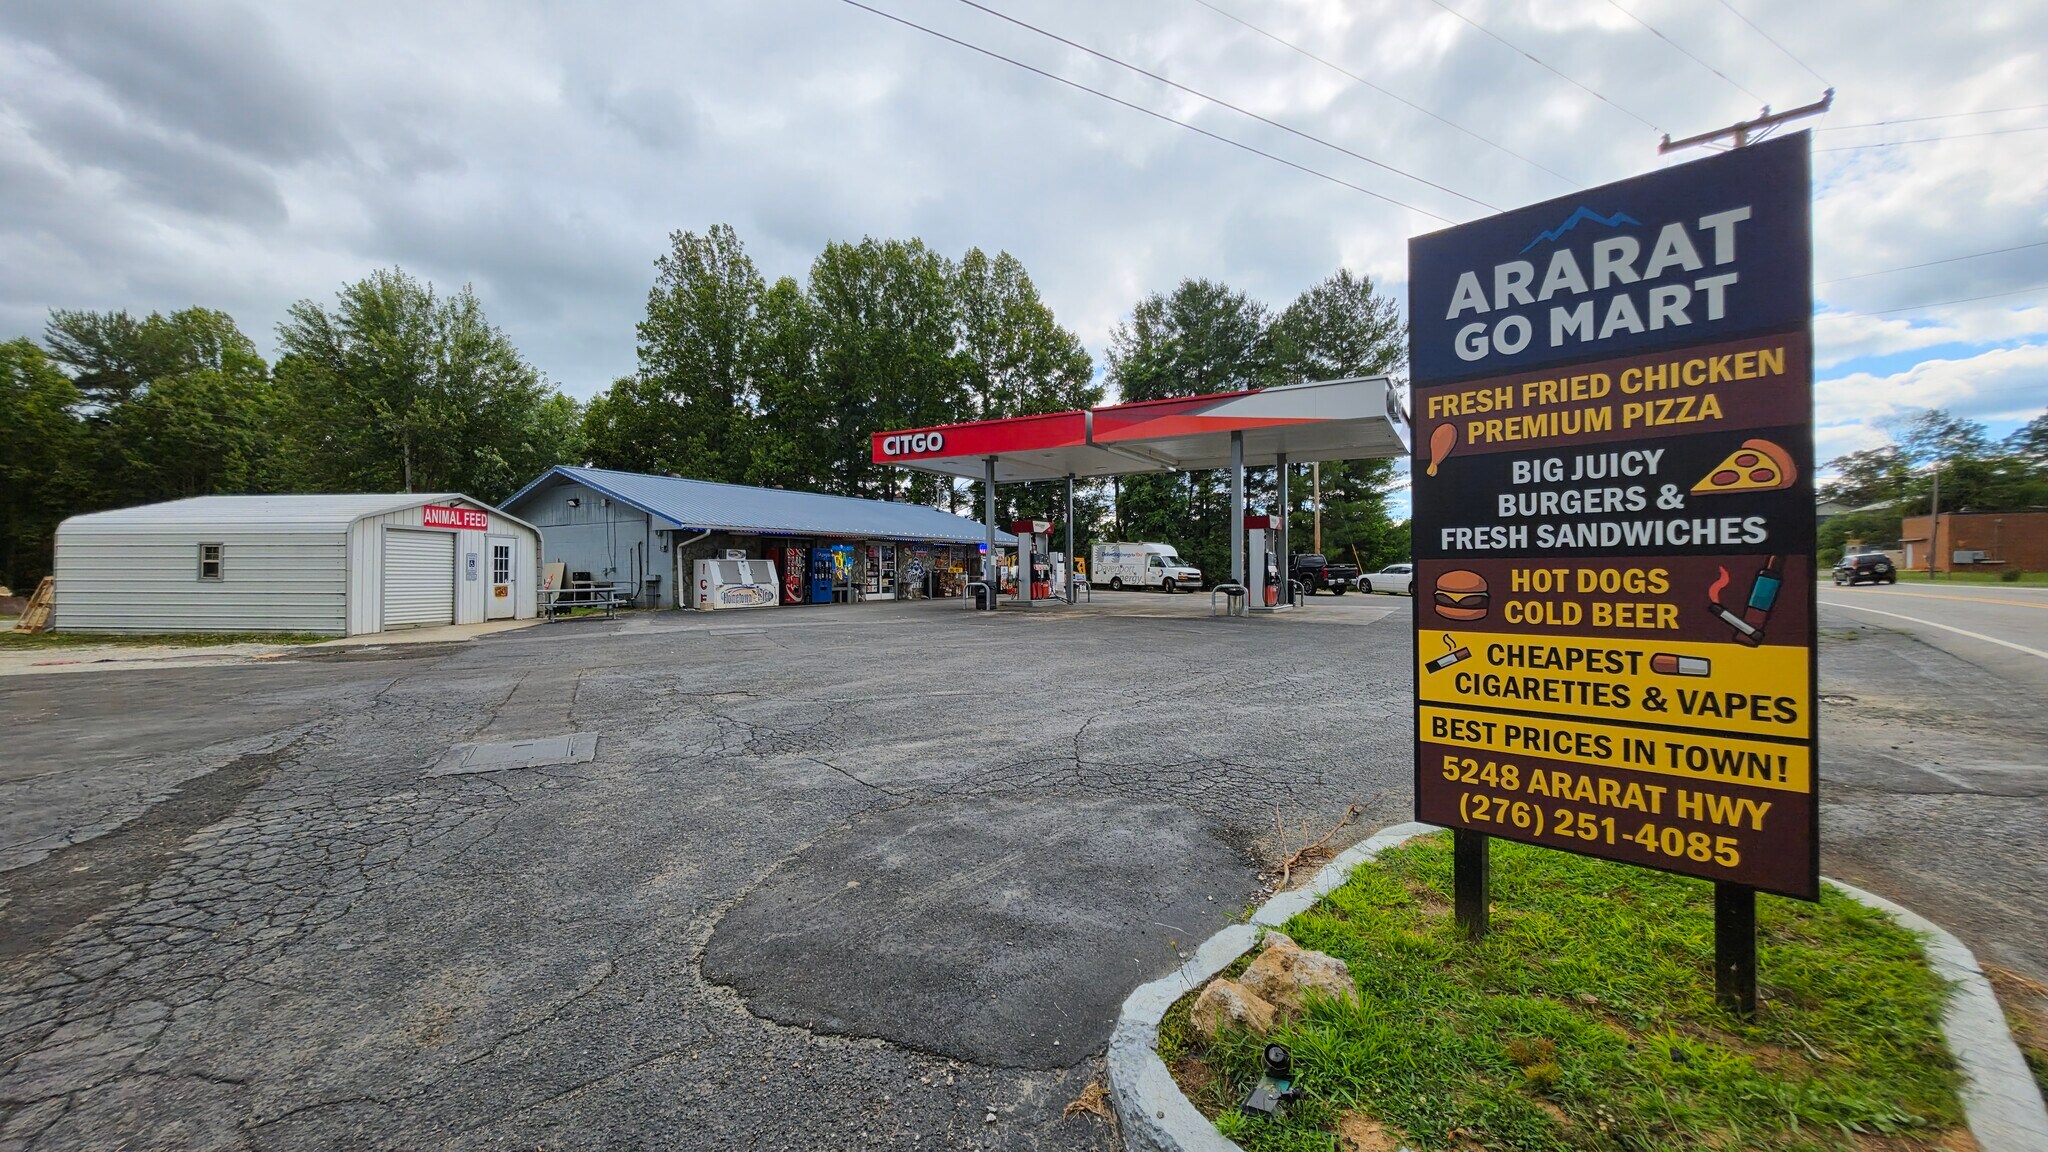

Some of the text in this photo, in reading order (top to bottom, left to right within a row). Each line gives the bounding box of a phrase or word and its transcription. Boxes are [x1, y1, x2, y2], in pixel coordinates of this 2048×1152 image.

[1446, 205, 1752, 321] ARARAT
[1454, 272, 1739, 362] GO MART
[1427, 347, 1785, 419] FRESH FRIED CHICKEN
[1467, 393, 1723, 445] PREMIUM PIZZA
[883, 432, 943, 455] CITGO
[1512, 448, 1665, 485] BIG JUICY
[424, 508, 488, 527] ANIMAL FEED
[1498, 483, 1685, 518] BURGERS &
[1441, 516, 1768, 550] FRESH SANDWICHES
[1096, 563, 1135, 574] Davenport
[1511, 568, 1670, 595] HOT DOGS
[723, 592, 753, 604] Hometown
[1504, 600, 1679, 630] COLD BEER
[1487, 643, 1644, 677] CHEAPEST
[1455, 672, 1798, 725] CIGARETTES & VAPES
[1432, 716, 1789, 783] BEST PRICES IN TOWN!
[1442, 755, 1772, 832] 5248 ARARAT HWY
[1459, 792, 1740, 869] (276) 251-4085
